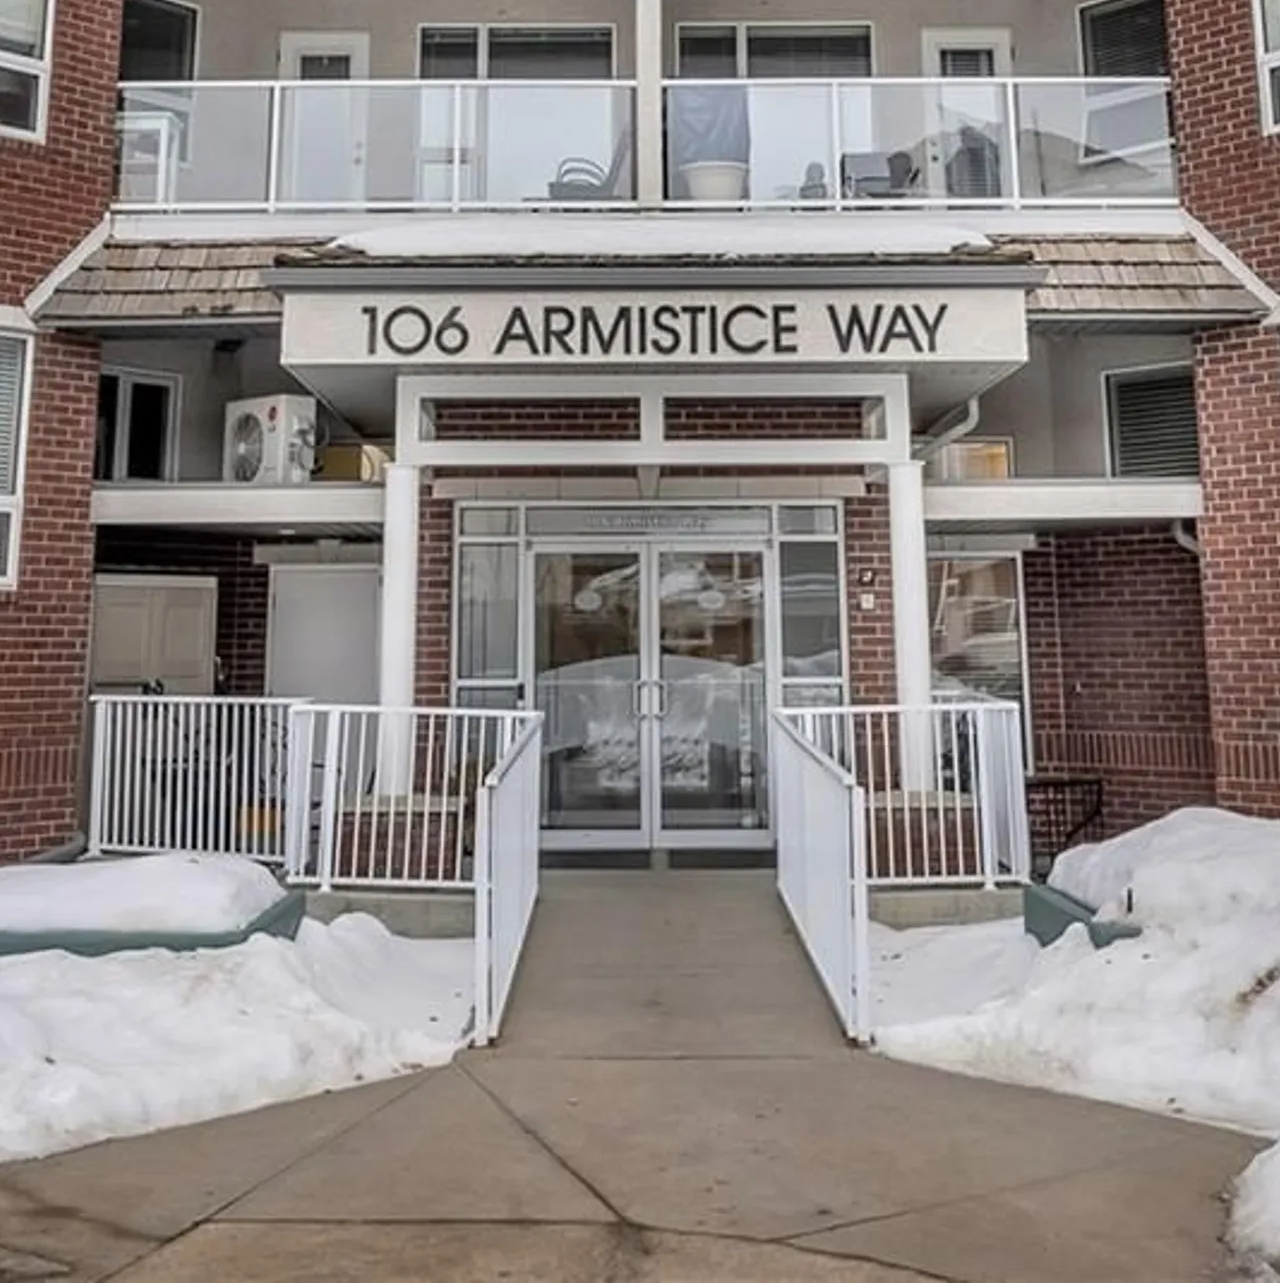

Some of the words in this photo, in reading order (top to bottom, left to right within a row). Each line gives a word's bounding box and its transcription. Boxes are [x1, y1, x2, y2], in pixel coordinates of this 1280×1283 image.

[361, 305, 470, 355] 106
[494, 305, 799, 355] ARMISTICE
[827, 303, 949, 354] WAY
